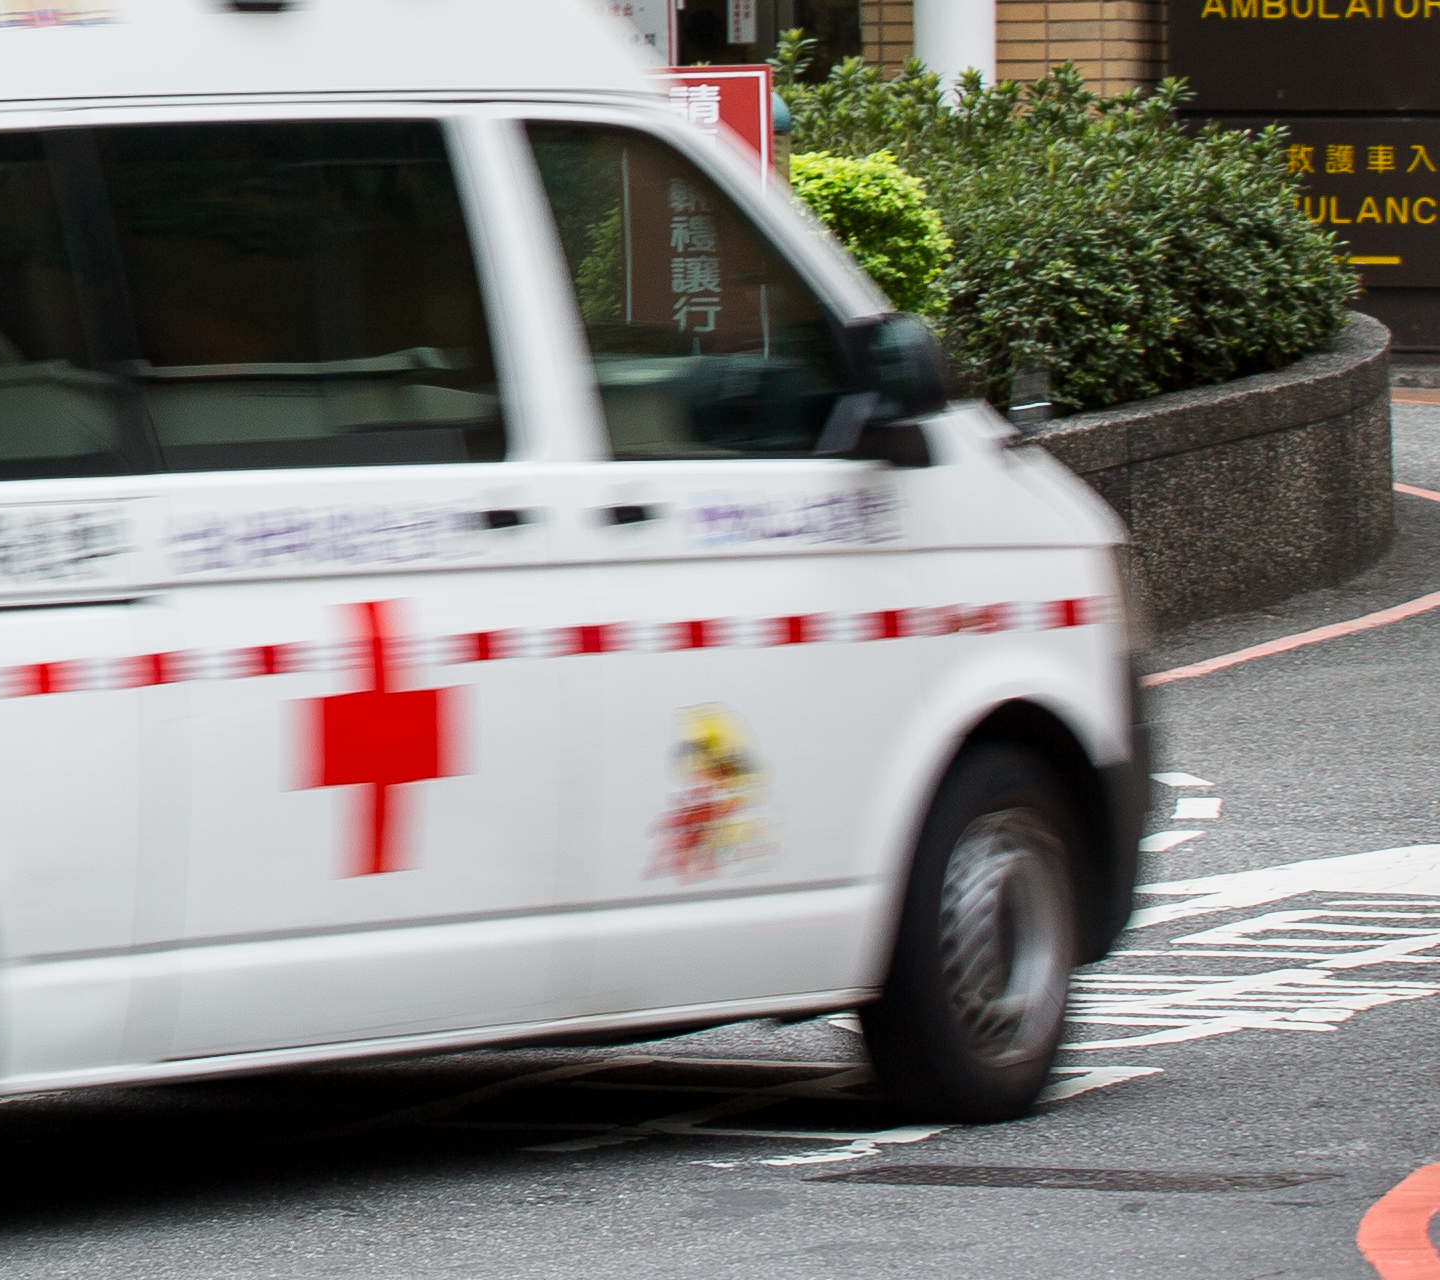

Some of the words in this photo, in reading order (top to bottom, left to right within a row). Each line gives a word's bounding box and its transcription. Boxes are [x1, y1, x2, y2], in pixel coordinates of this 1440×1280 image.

[1286, 143, 1437, 174] 救護車入
[1293, 196, 1438, 224] ULANC
